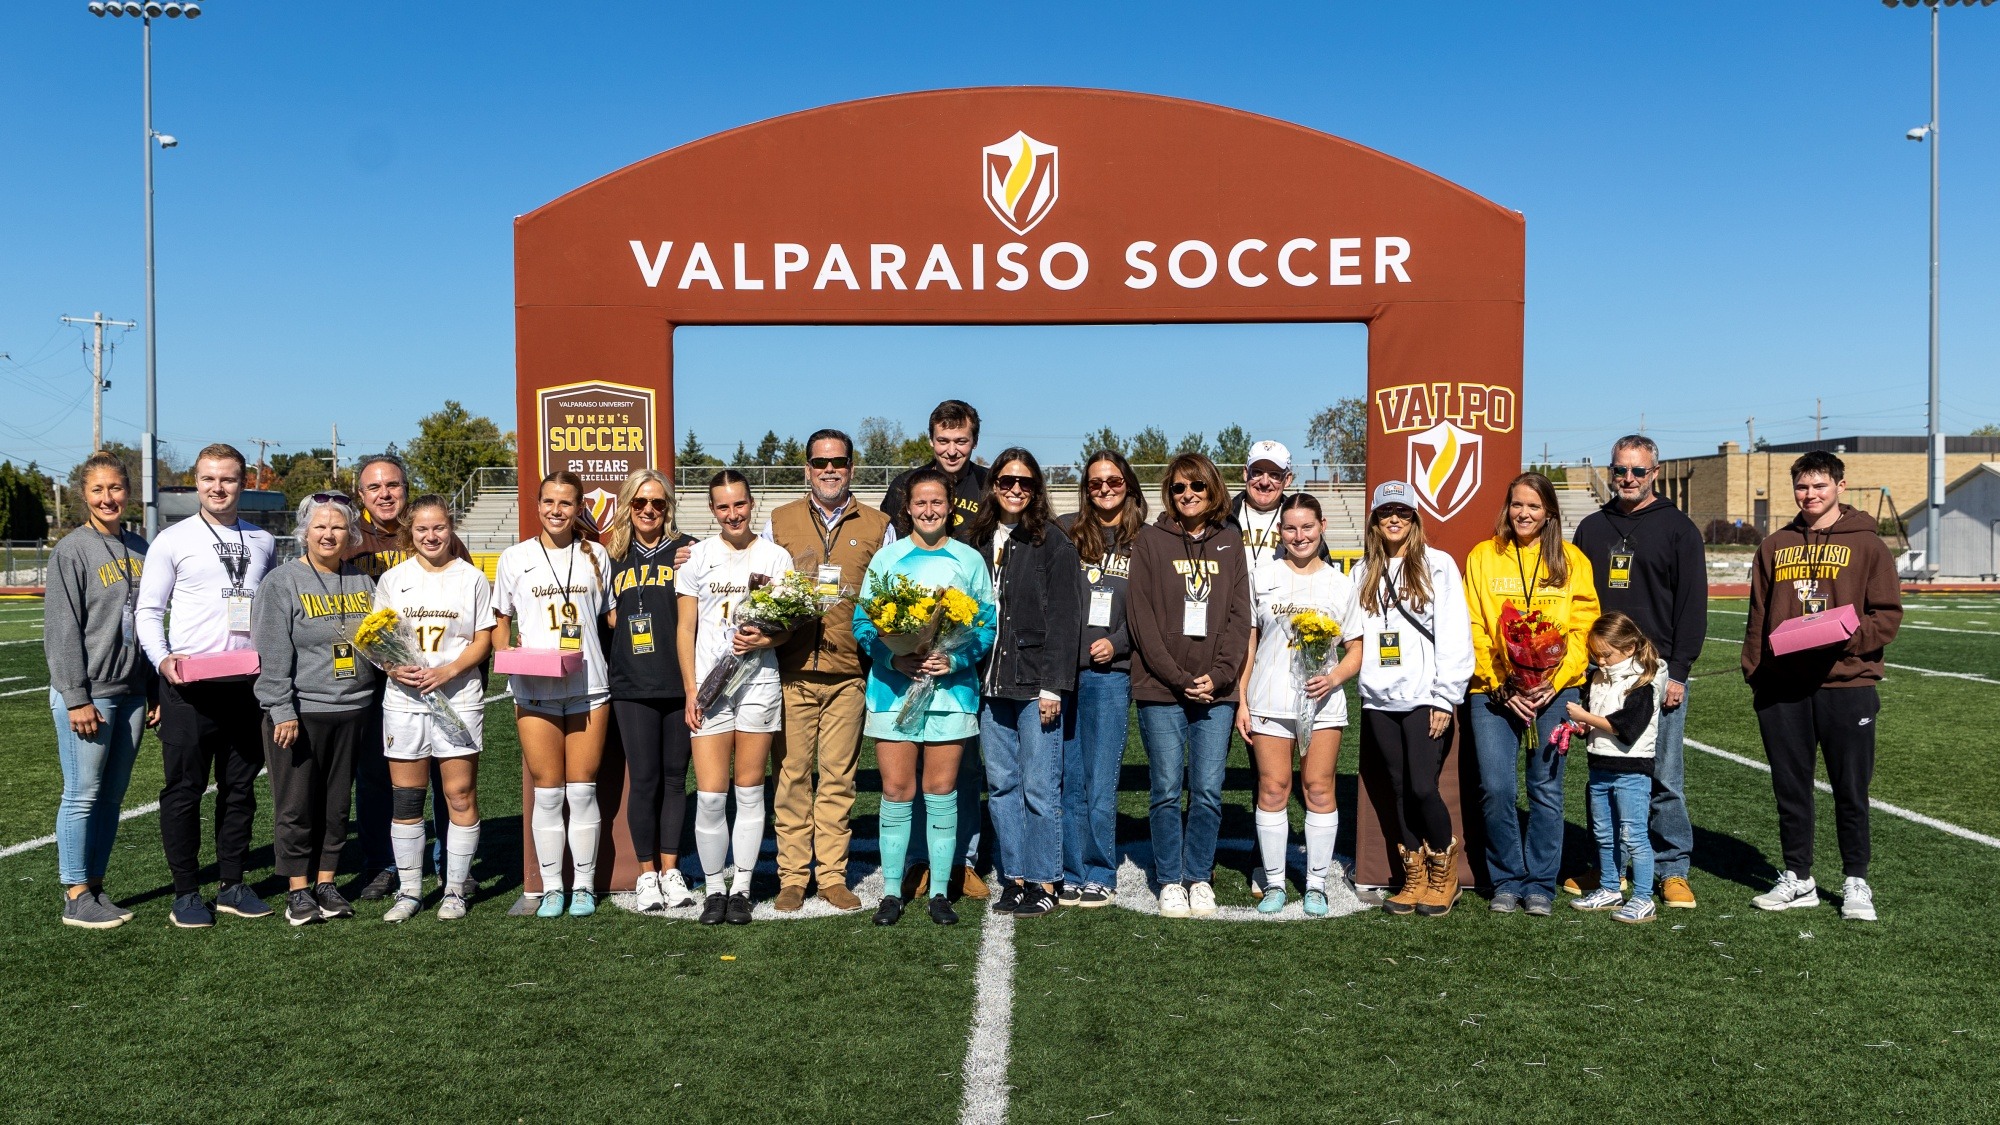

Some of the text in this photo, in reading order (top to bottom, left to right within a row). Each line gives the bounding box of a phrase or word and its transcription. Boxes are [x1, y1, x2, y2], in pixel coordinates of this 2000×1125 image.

[629, 236, 1412, 290] VALPARAISO SOCCER
[565, 413, 629, 424] WOMEN'S
[1376, 383, 1515, 434] VALPO
[549, 426, 645, 452] SOCCER
[568, 459, 629, 472] 25 YEARS
[580, 474, 629, 482] EXCELLENCE
[213, 543, 251, 558] VALPO
[614, 564, 676, 597] VALP
[709, 581, 746, 597] Valpar
[403, 606, 459, 621] Valparaiso
[547, 602, 578, 630] 19
[416, 625, 446, 653] 17
